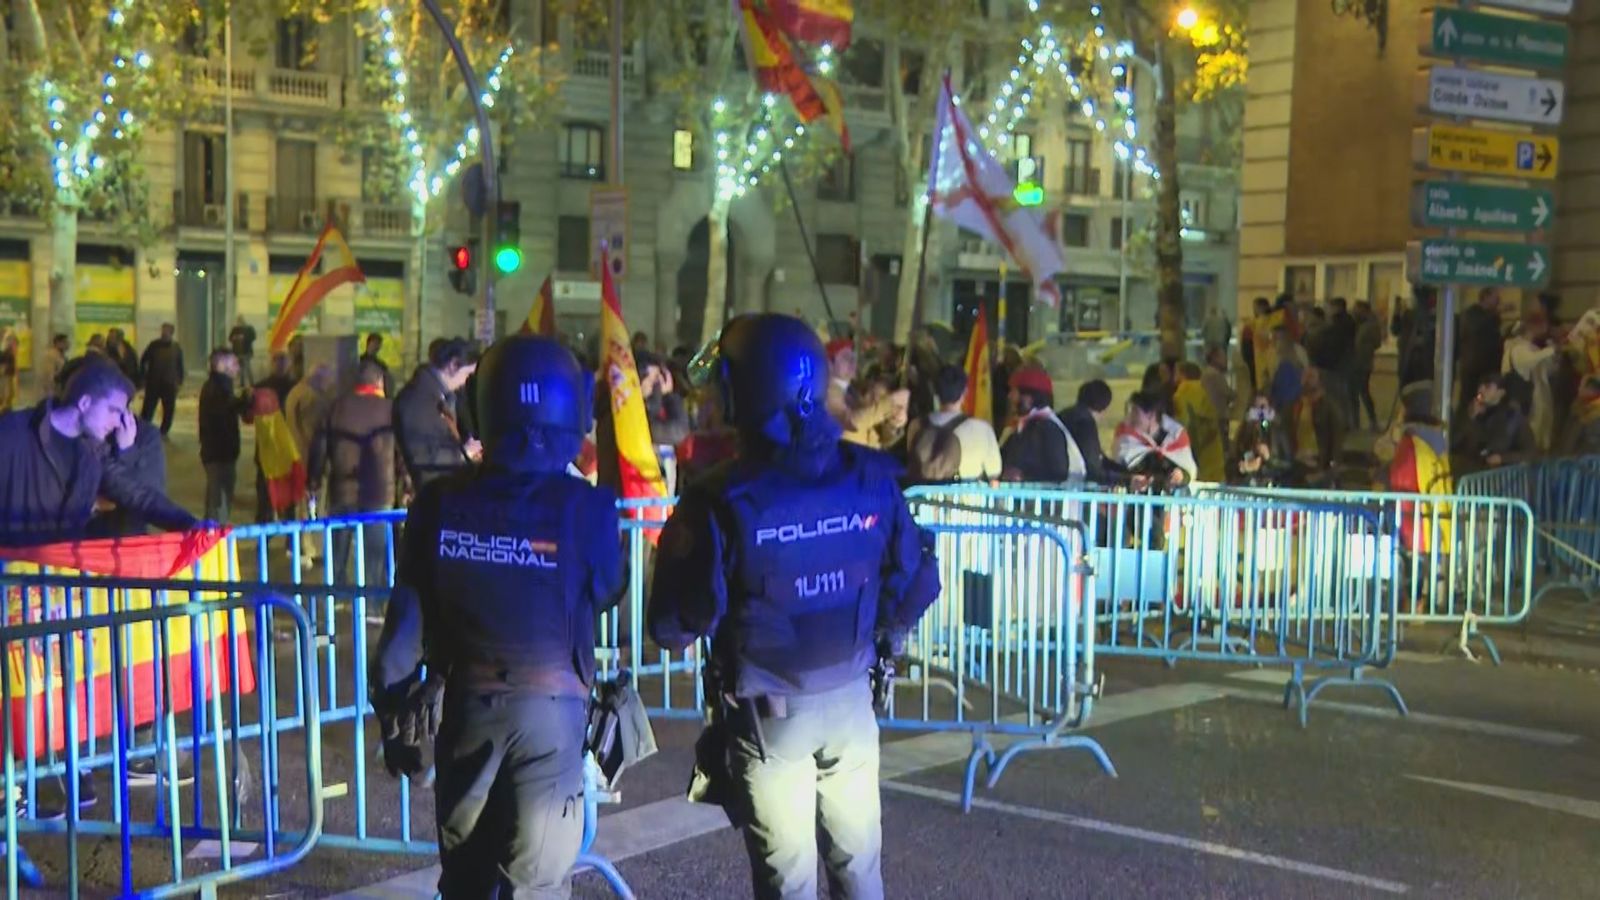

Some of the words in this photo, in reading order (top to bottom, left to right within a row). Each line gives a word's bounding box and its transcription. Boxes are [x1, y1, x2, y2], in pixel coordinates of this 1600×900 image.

[440, 529, 533, 552] POLICIA
[755, 513, 863, 546] POLICIA
[440, 544, 557, 568] NACIONAL
[795, 569, 844, 598] 1U111
